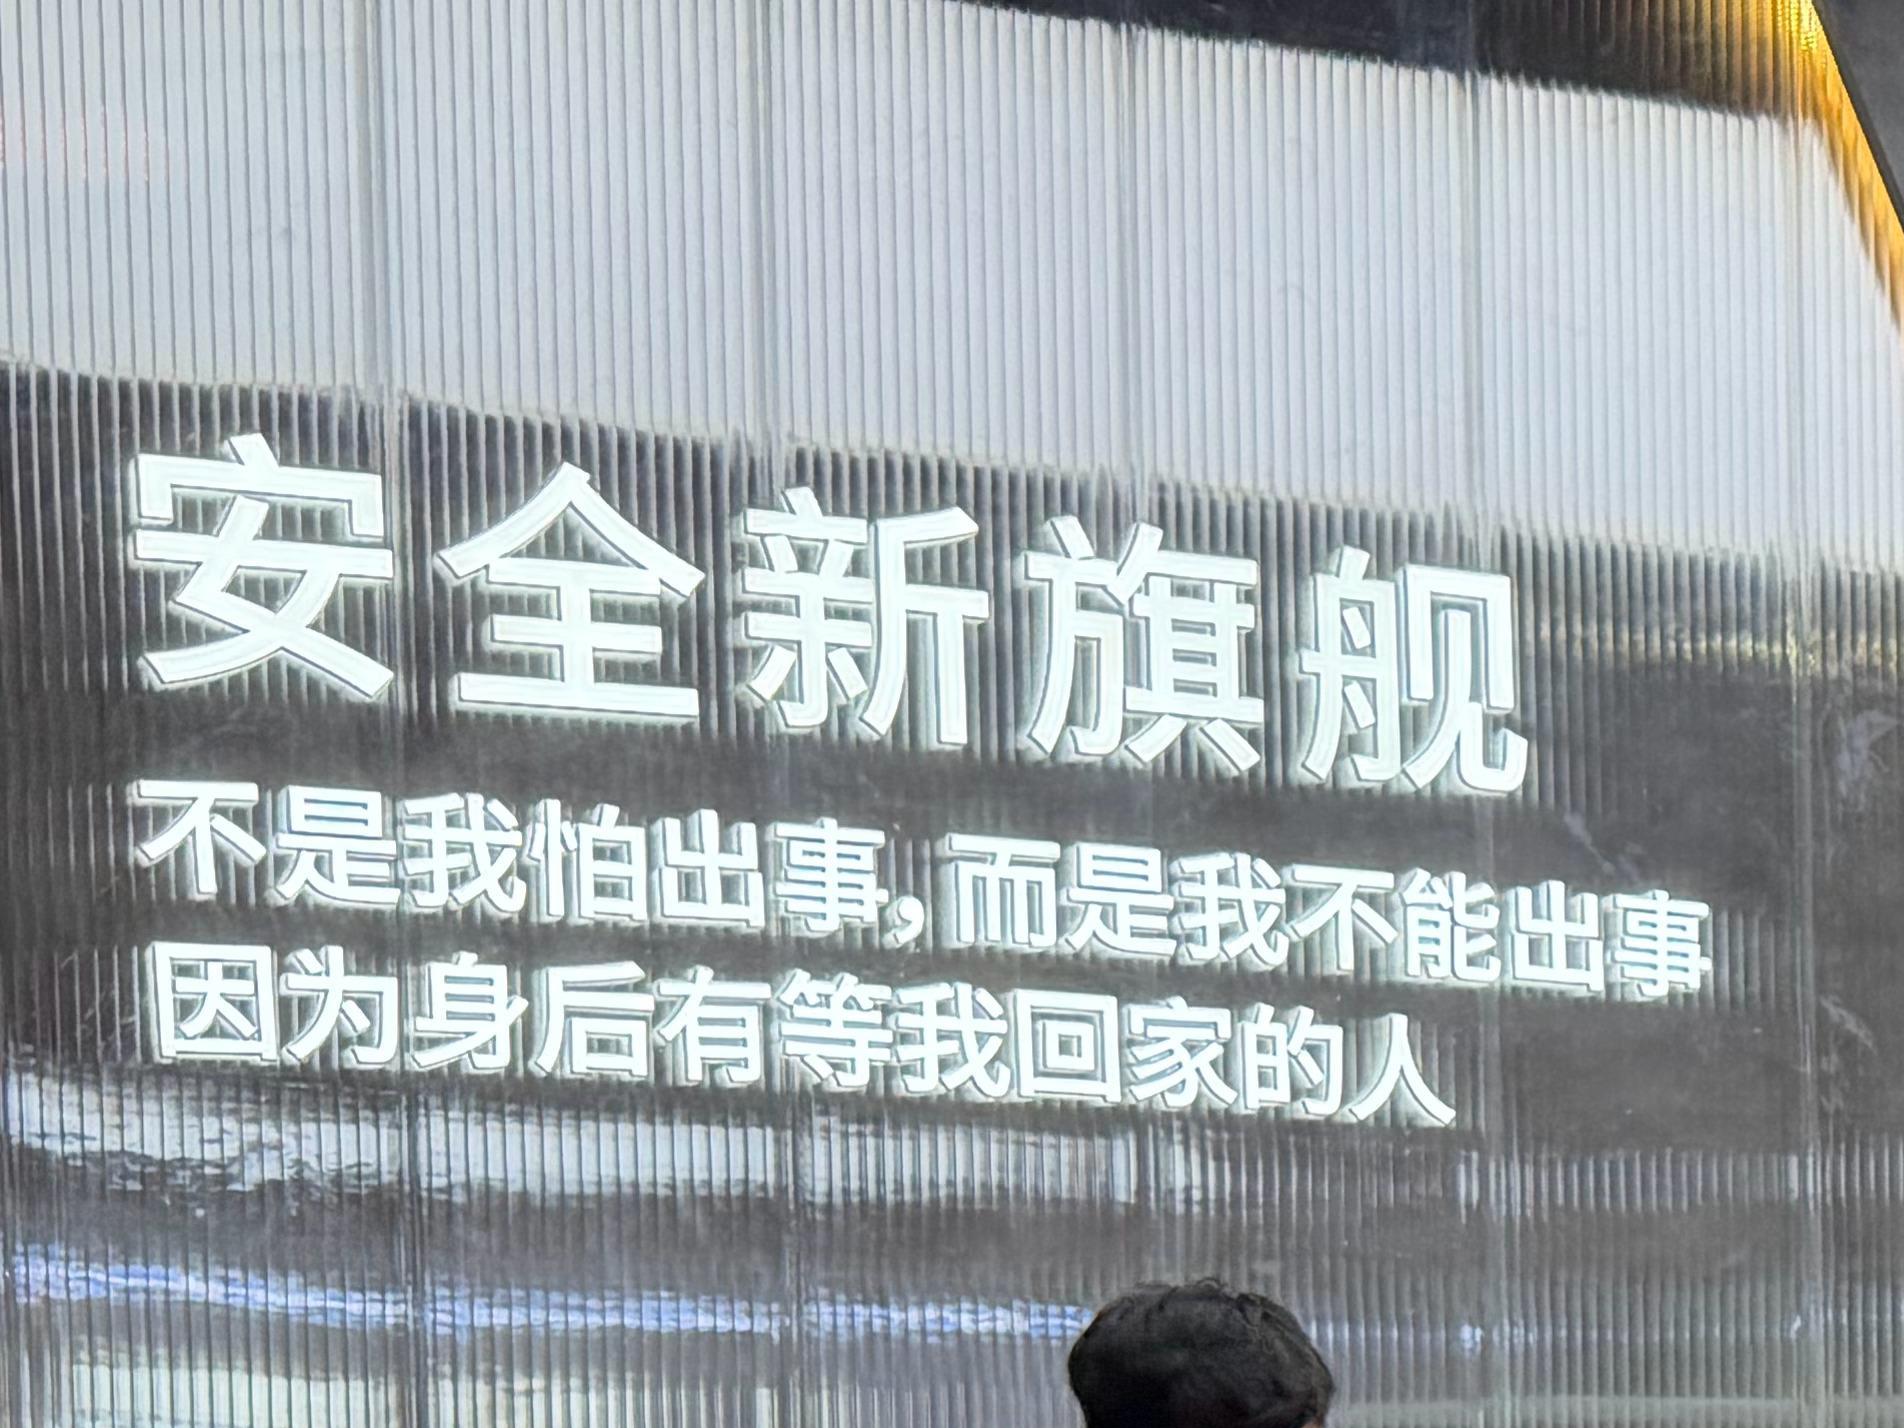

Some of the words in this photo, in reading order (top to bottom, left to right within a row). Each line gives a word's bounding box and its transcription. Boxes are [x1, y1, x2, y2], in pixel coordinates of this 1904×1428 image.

[133, 432, 1529, 796] 安全新旗舰
[150, 941, 1457, 1127] 因为身后有等我回家的人
